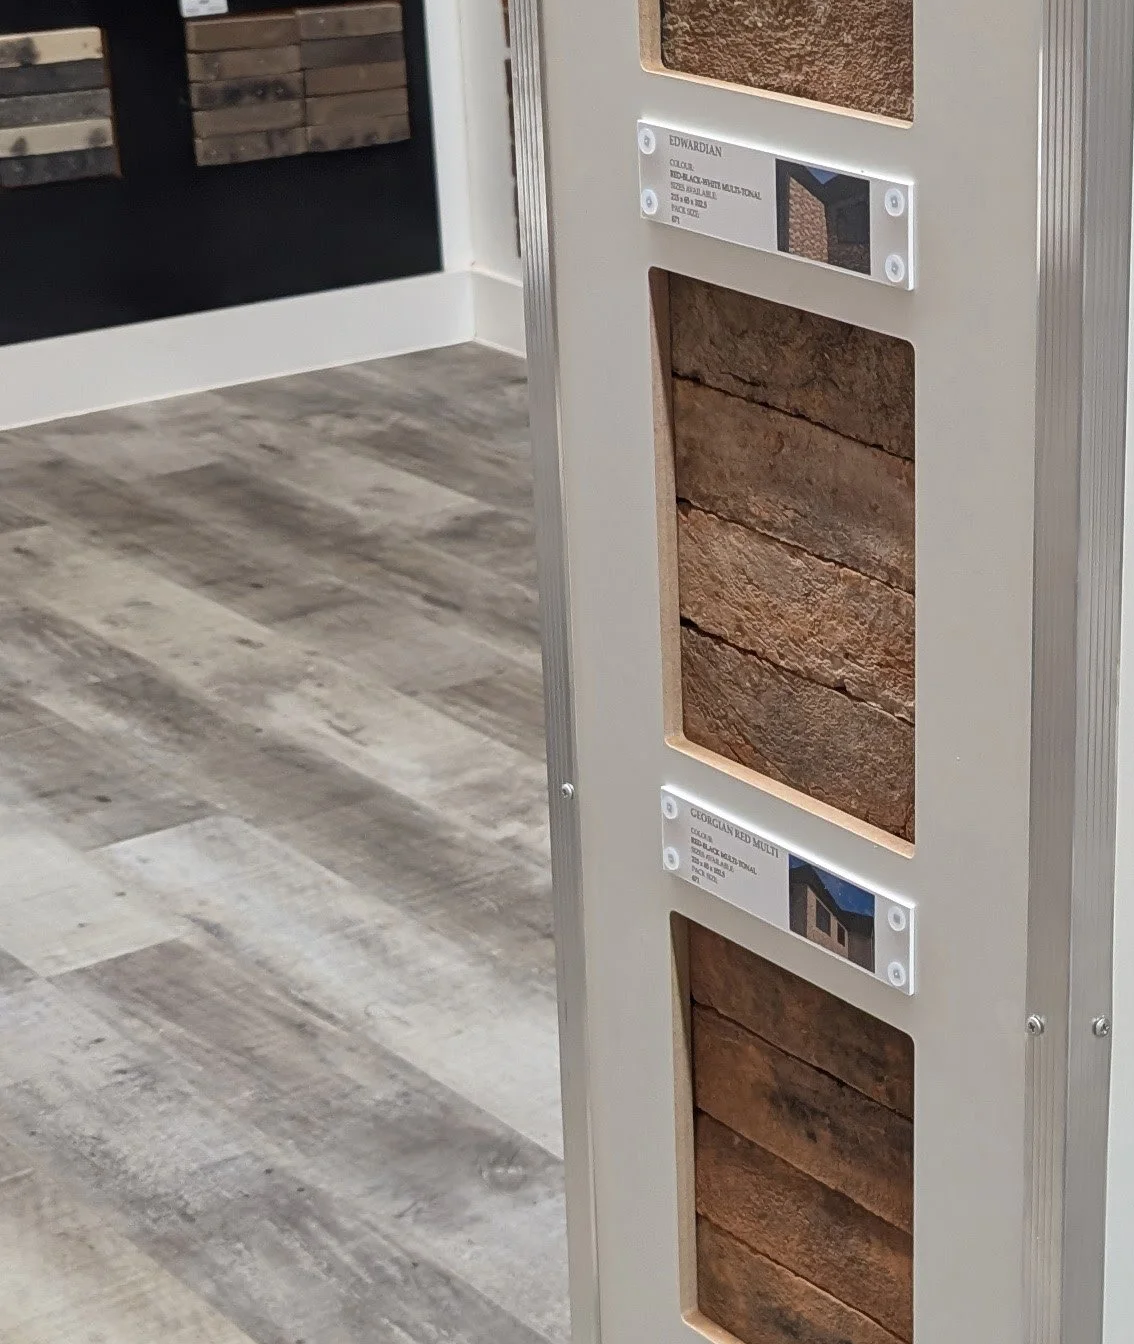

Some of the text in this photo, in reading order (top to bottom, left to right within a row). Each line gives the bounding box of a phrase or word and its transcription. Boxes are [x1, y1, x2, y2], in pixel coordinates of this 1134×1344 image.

[669, 135, 721, 157] EDWARDIAN
[722, 183, 761, 200] MULTI-TONAL
[691, 808, 779, 858] GEORGIAN RED MULTI
